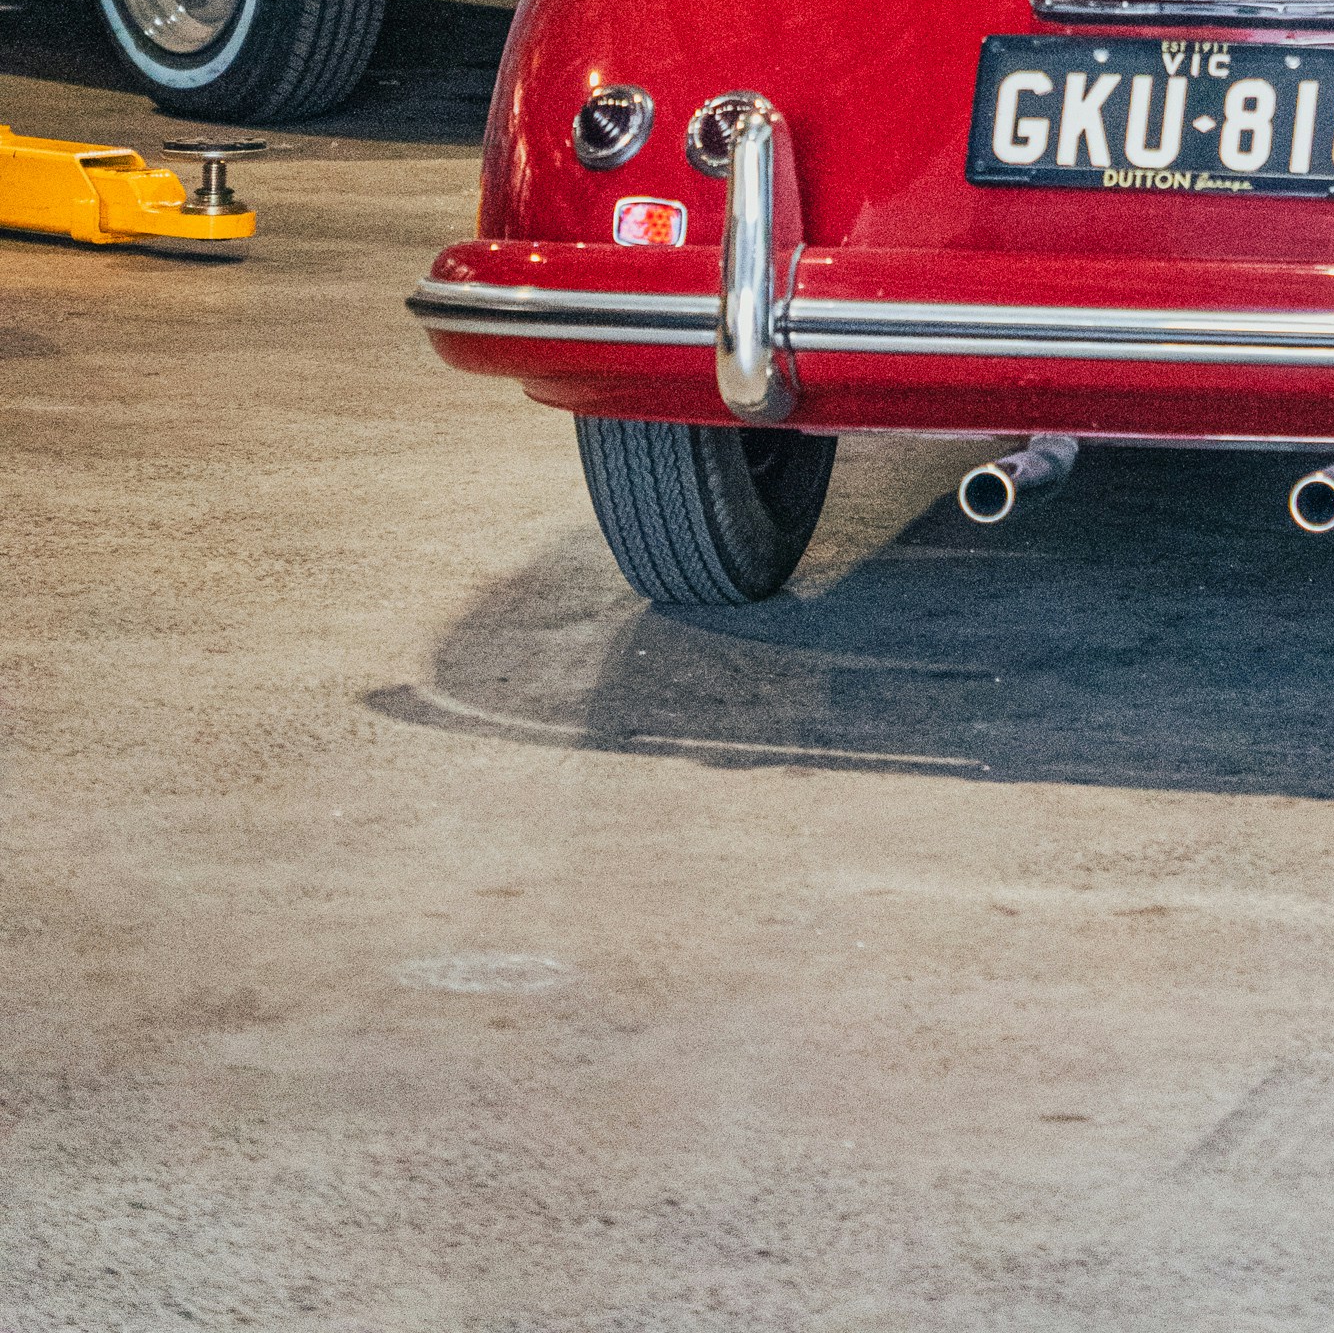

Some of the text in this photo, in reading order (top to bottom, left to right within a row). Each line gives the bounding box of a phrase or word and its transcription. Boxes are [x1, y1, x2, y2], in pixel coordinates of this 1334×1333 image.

[1161, 39, 1229, 54] EST 1911
[1162, 52, 1232, 79] VIC
[1102, 168, 1192, 189] DUTTON
